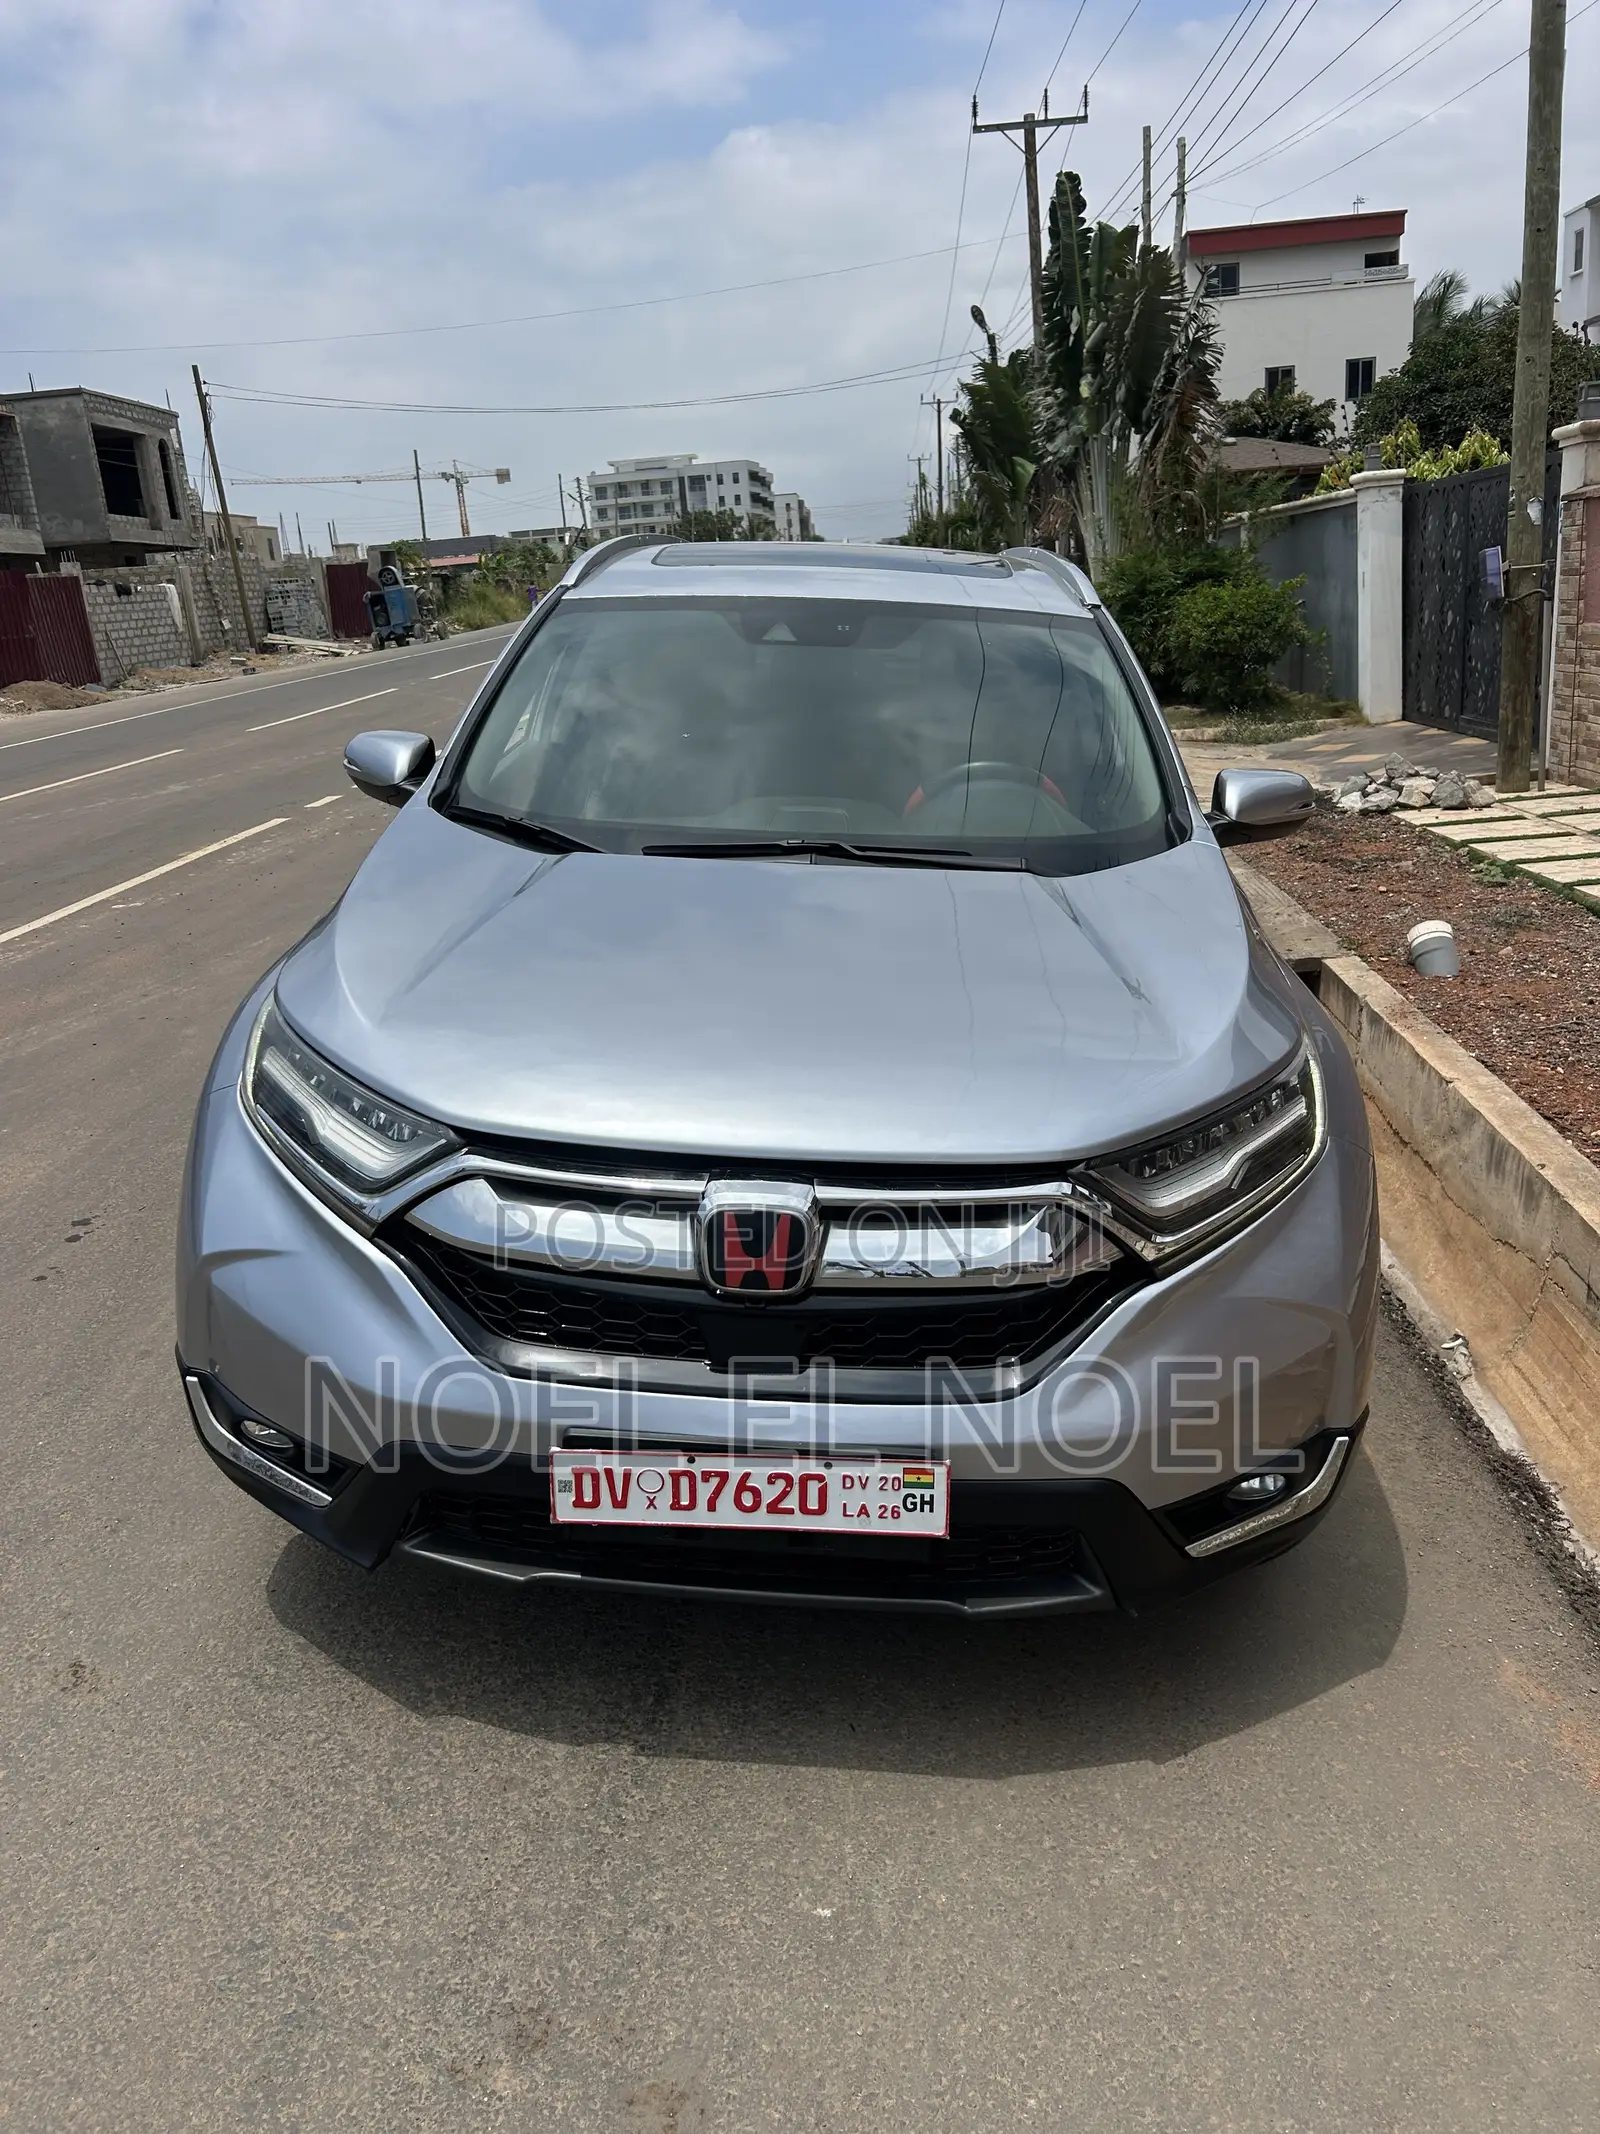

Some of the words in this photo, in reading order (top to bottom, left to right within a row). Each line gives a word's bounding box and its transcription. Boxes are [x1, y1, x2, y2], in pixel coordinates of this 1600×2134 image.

[571, 1466, 632, 1509] DV
[668, 1468, 828, 1516] D7620
[842, 1473, 869, 1491] DV
[878, 1476, 902, 1491] 20
[842, 1502, 870, 1518] LA
[878, 1504, 901, 1519] 26
[902, 1492, 935, 1513] GH
